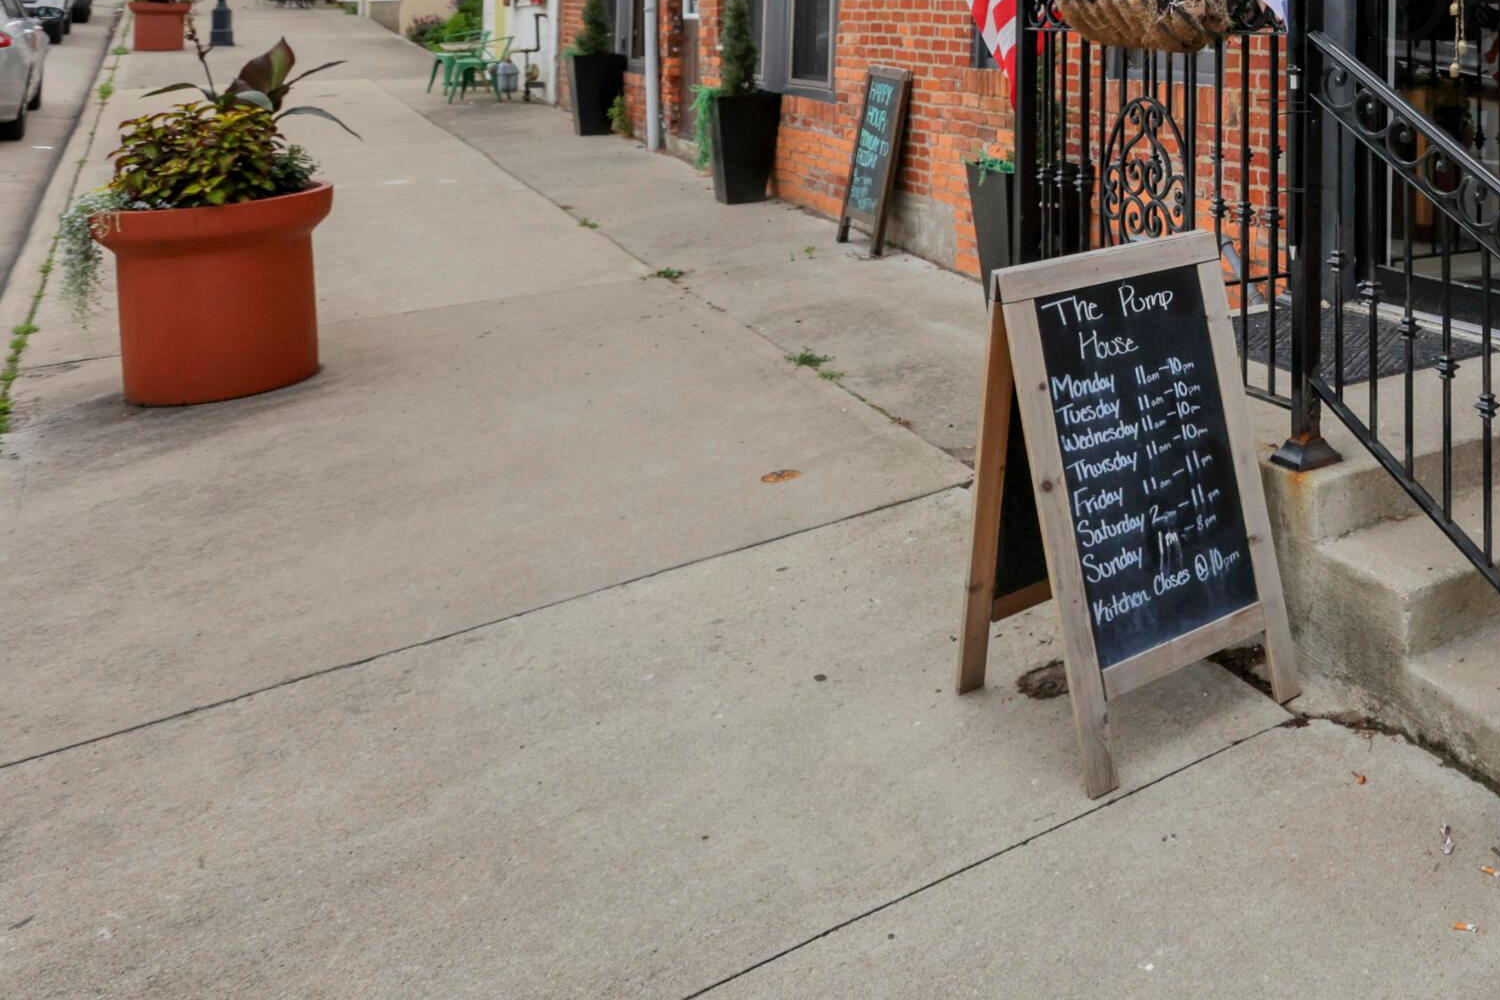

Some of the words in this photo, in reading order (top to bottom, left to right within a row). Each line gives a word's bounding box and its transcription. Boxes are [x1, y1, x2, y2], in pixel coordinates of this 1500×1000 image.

[866, 104, 887, 133] HOUR
[1041, 295, 1104, 326] The
[1118, 285, 1173, 317] Pump
[1078, 329, 1139, 360] House
[1051, 371, 1115, 401] Monday
[1055, 398, 1120, 426] Tuesday
[1061, 420, 1138, 452] Wednesday
[1066, 450, 1137, 482] Thursday
[1073, 486, 1123, 518] Friday
[1077, 513, 1145, 548] Saturday
[1082, 547, 1142, 583] Sunday
[1093, 589, 1151, 626] Kitchen
[1154, 568, 1191, 596] Closes
